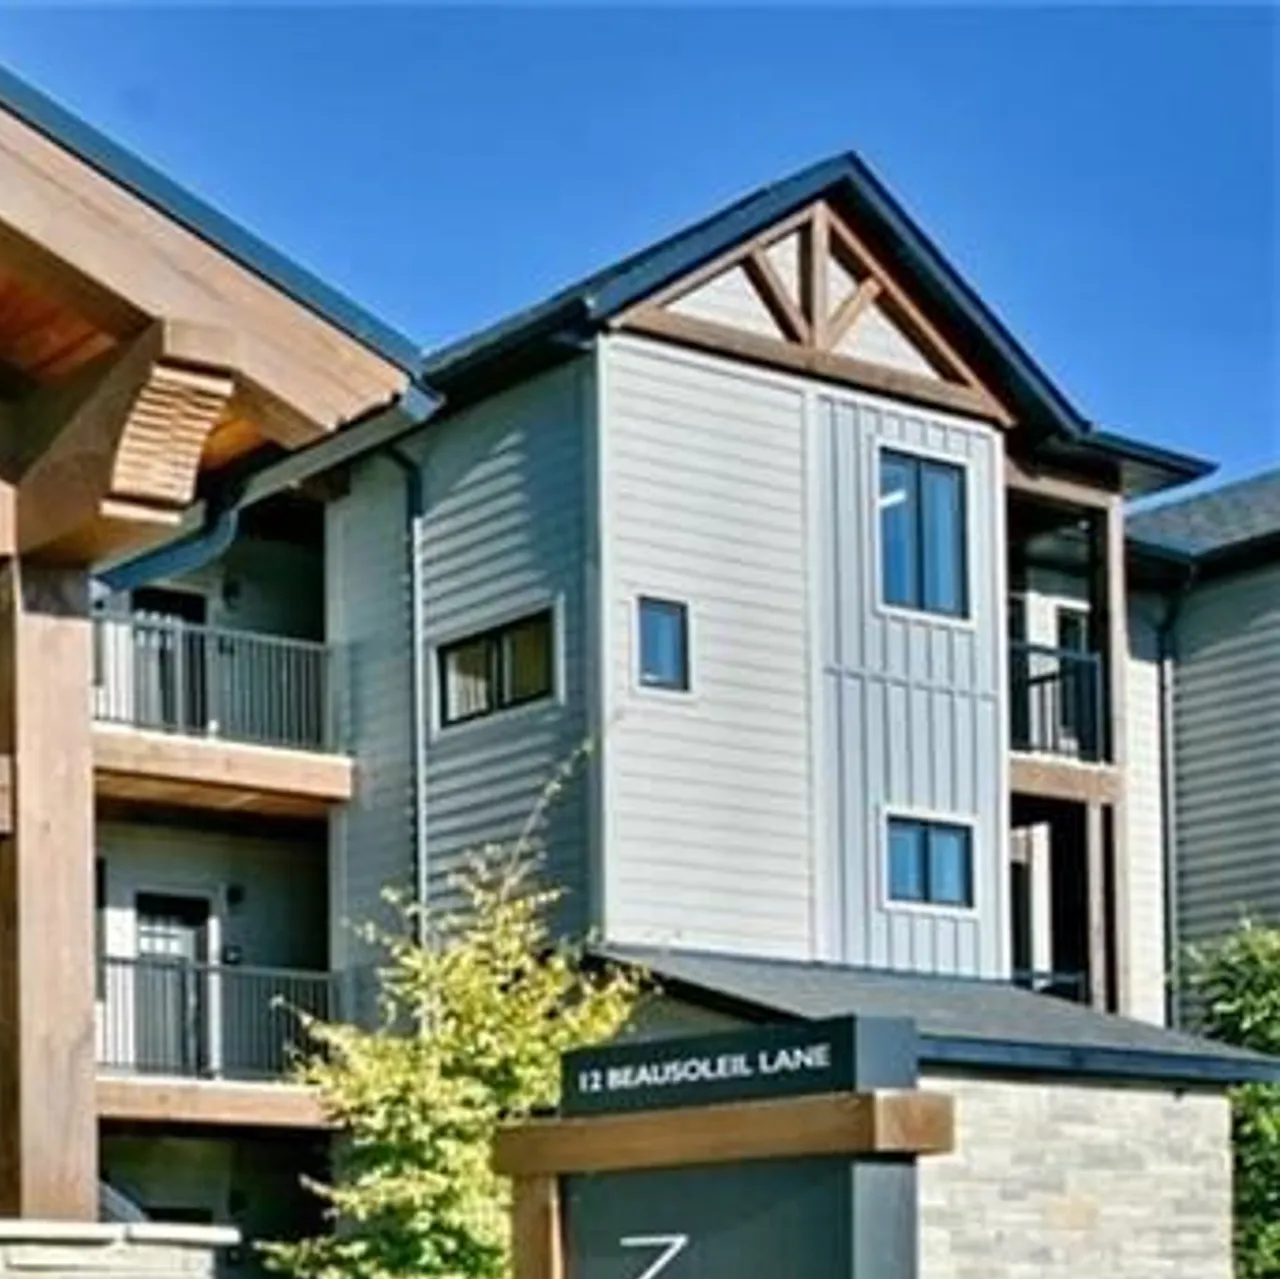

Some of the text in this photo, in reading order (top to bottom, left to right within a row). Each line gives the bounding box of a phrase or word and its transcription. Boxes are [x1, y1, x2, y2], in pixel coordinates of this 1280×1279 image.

[578, 1043, 832, 1093] 12 BEAUSOLEIL LANE
